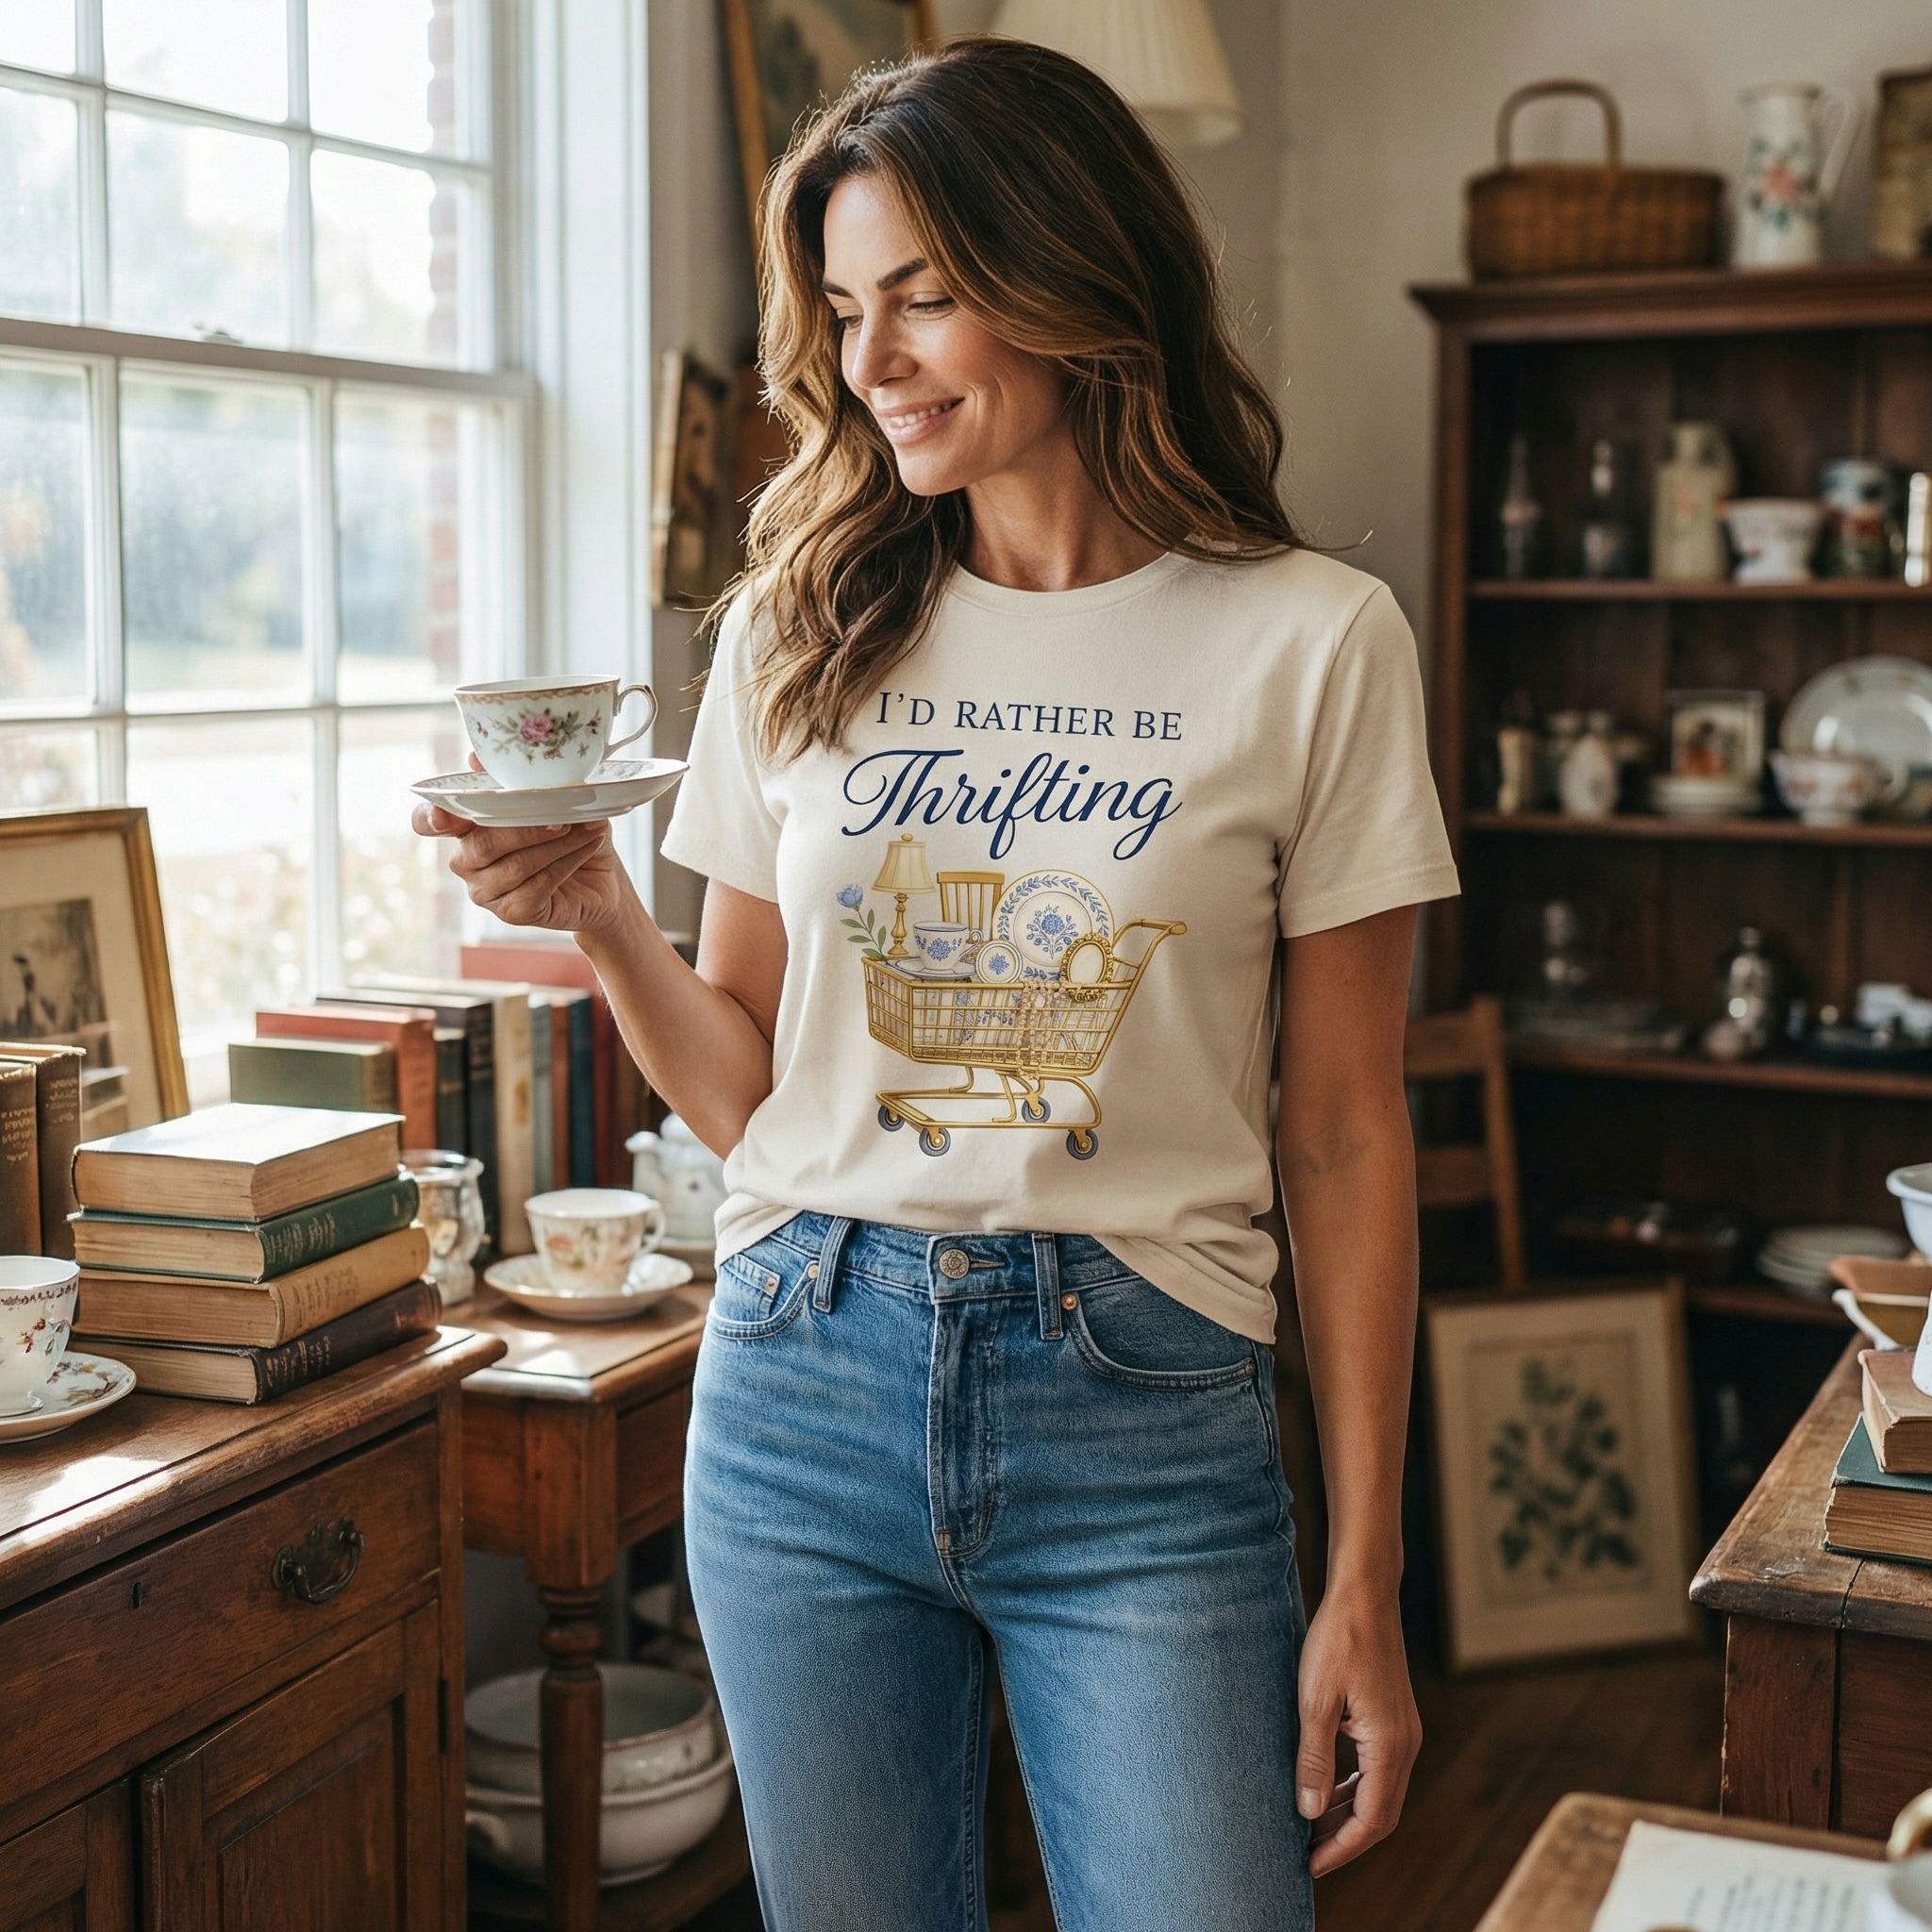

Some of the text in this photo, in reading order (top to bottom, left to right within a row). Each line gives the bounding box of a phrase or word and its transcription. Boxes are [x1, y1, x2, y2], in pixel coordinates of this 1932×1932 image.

[954, 700, 1116, 737] RATHER
[1132, 710, 1182, 741] BE
[841, 749, 1182, 860] Thrifting
